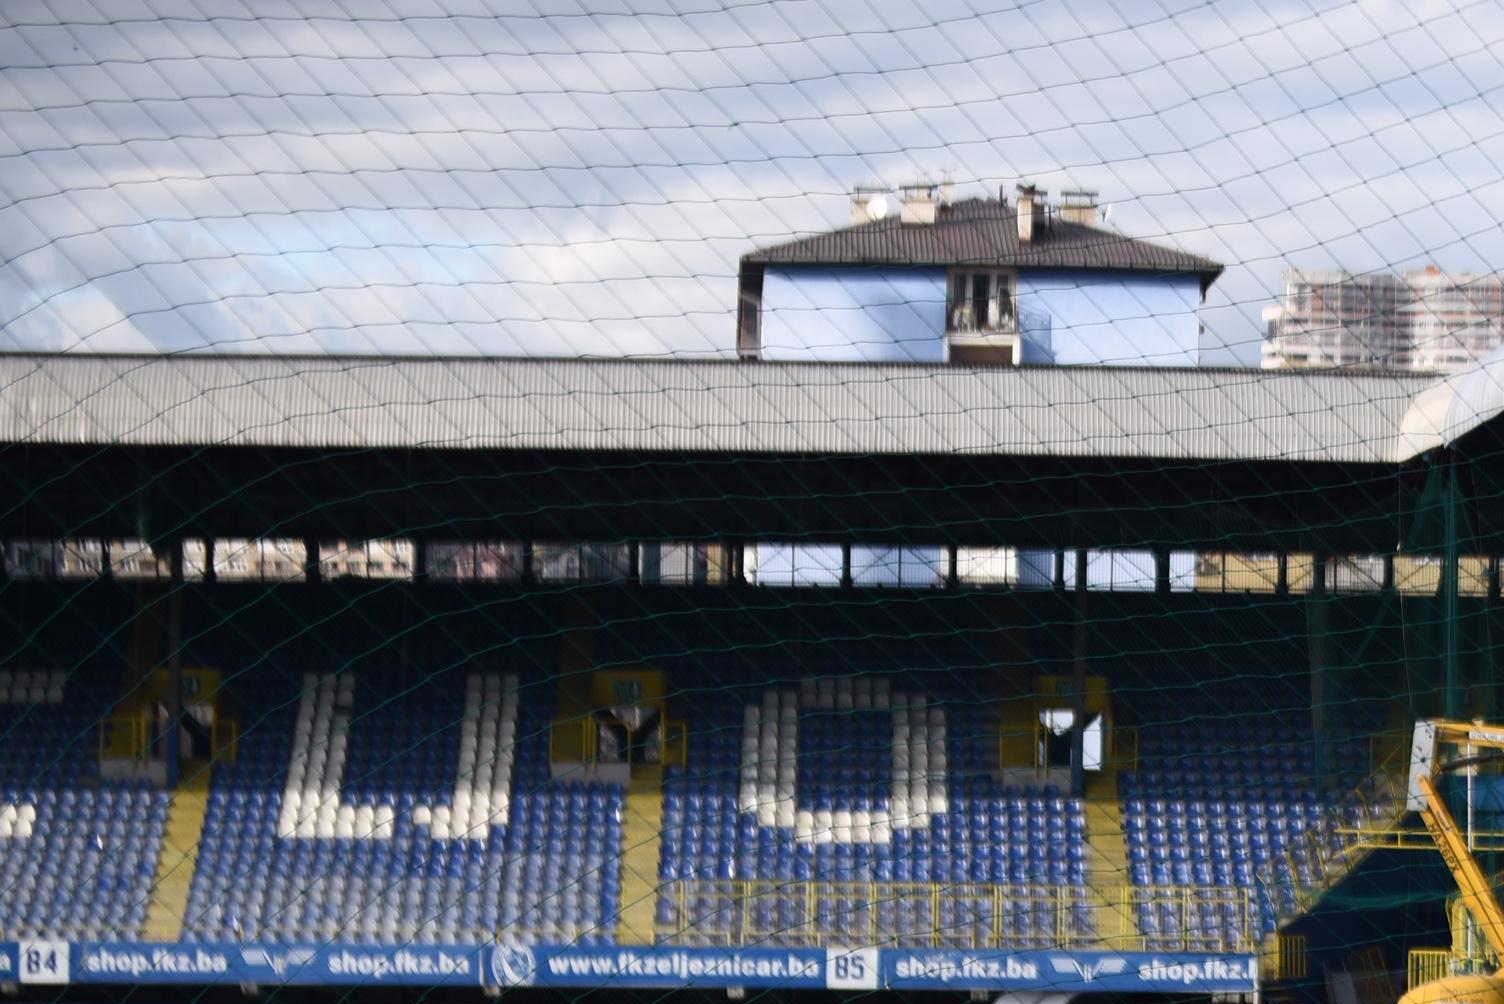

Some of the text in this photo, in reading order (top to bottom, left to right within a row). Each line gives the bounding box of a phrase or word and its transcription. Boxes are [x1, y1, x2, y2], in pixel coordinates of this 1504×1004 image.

[1427, 822, 1460, 873] HA26PX
[87, 948, 229, 976] shop.fkz.ba
[328, 950, 471, 979] shop.fkz.ba
[549, 953, 820, 980] www.fkzeljeznicar.ba
[895, 956, 1037, 982] shop.fkz.ba
